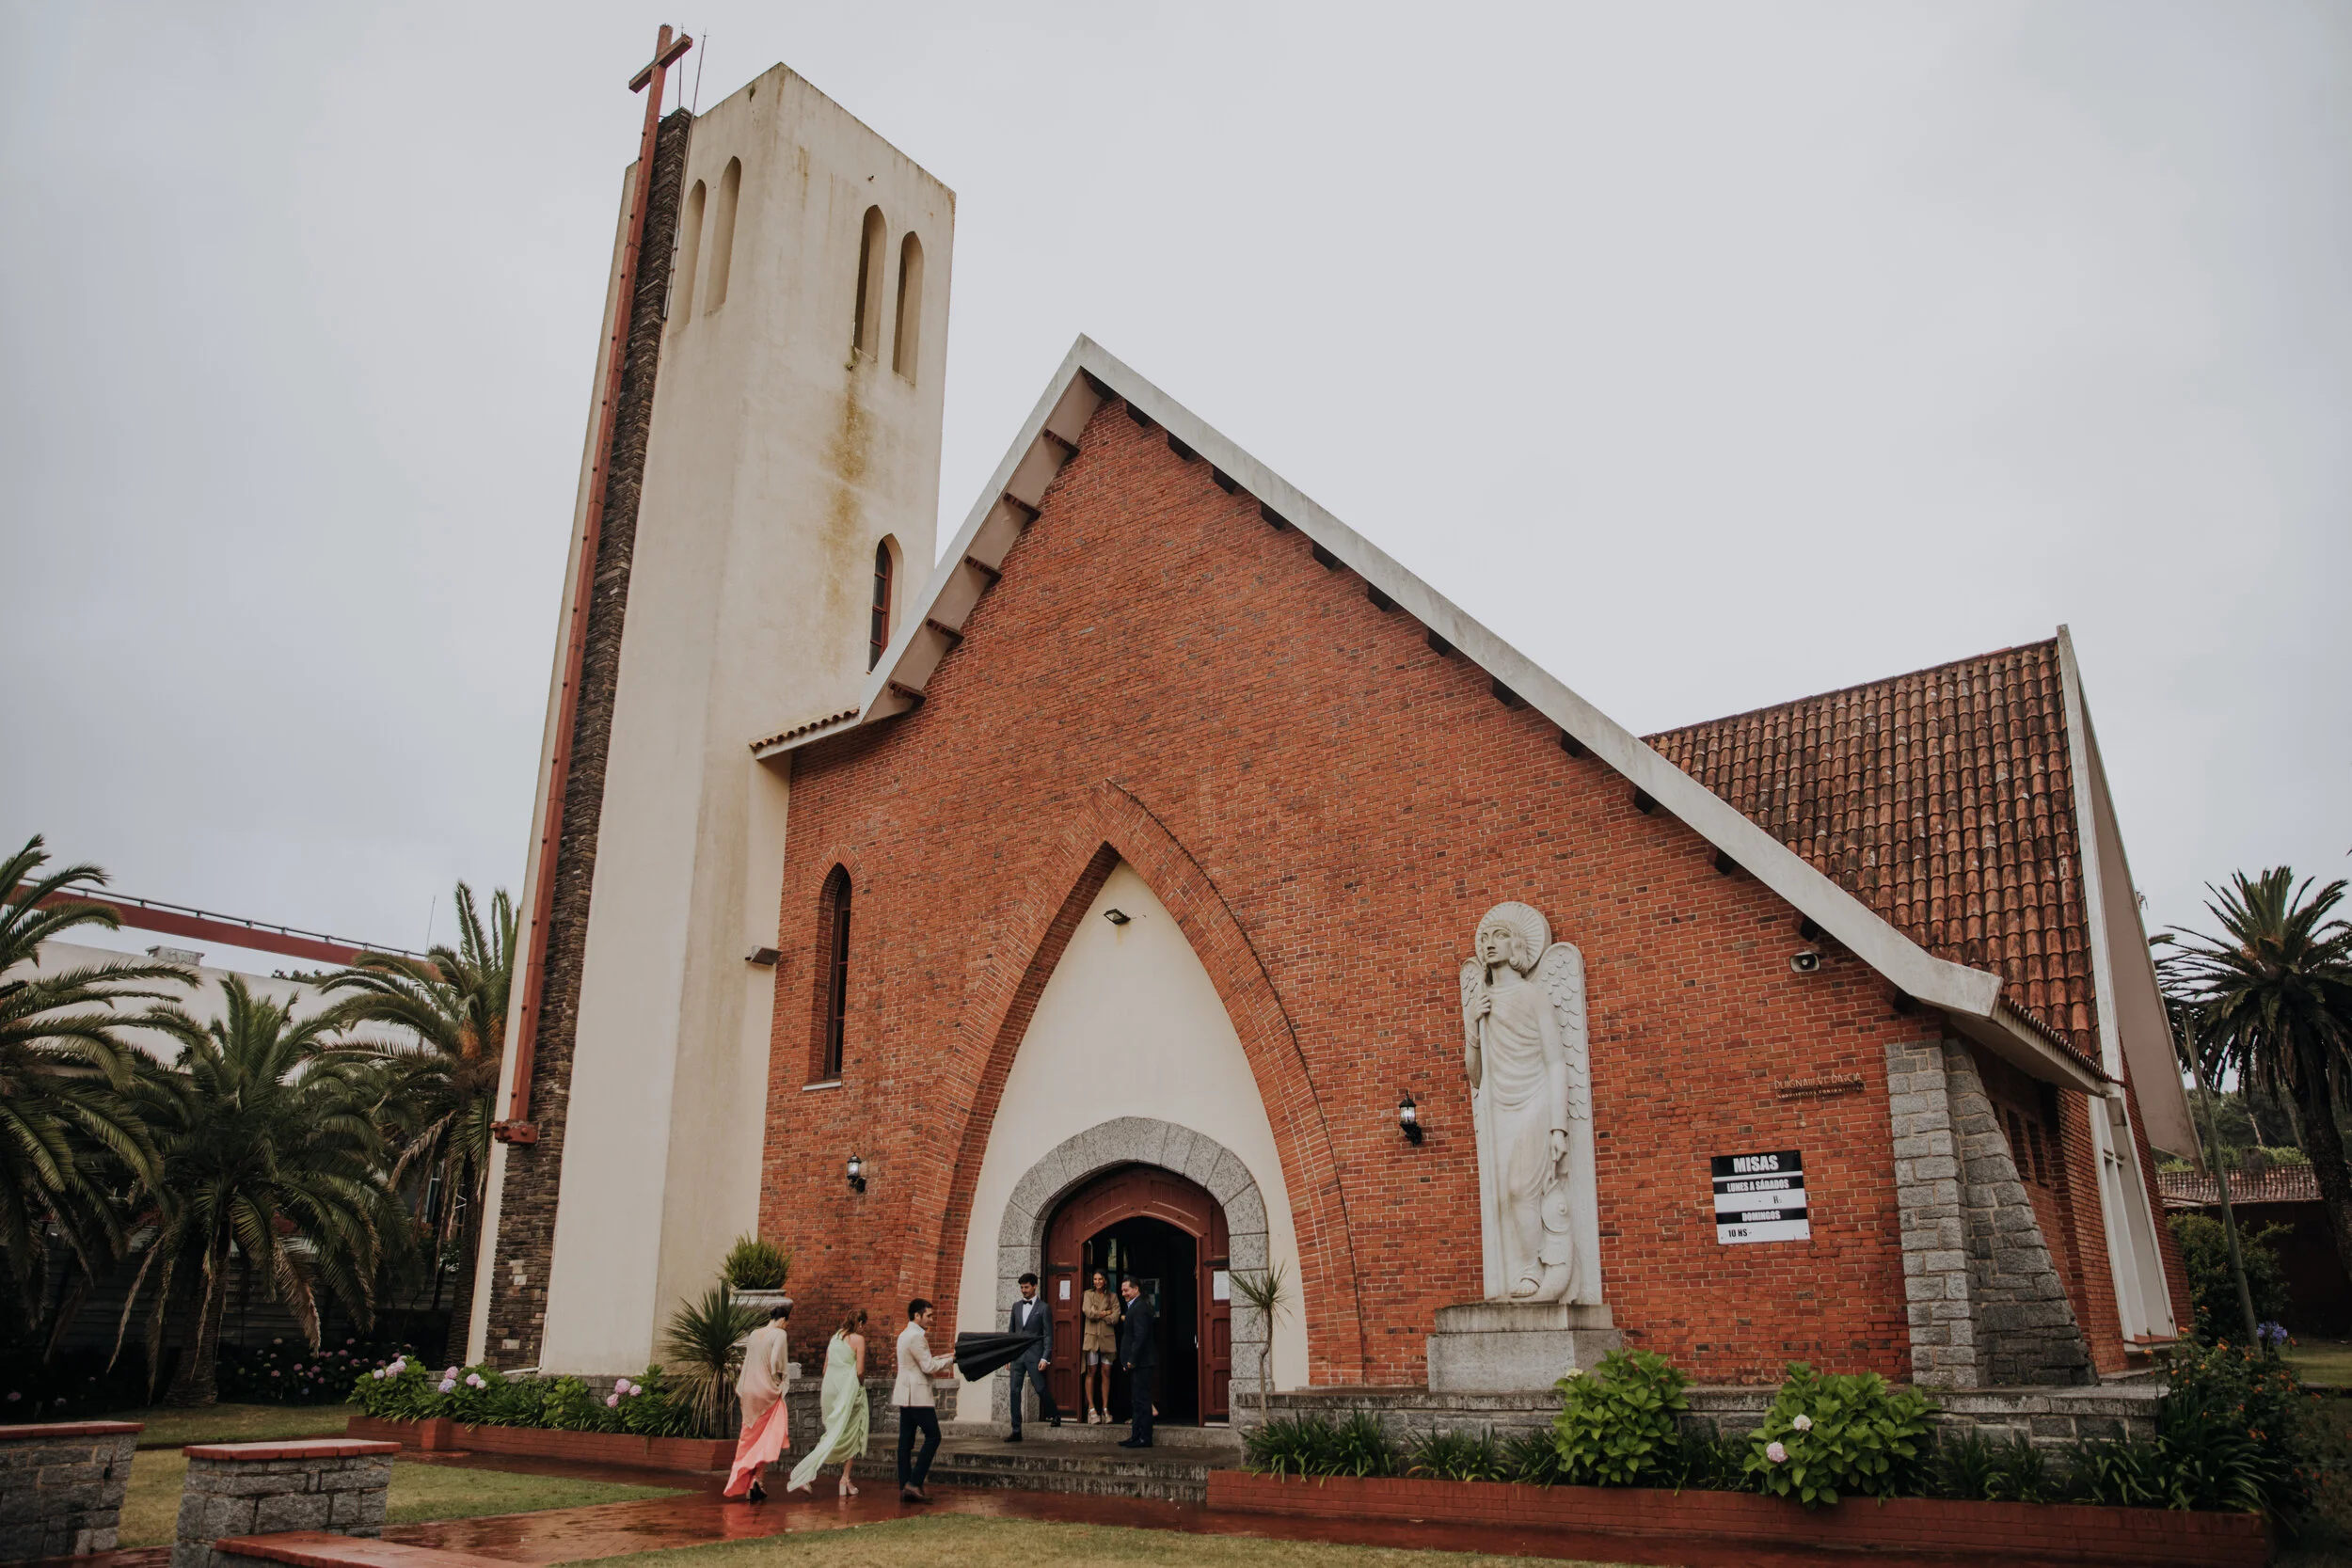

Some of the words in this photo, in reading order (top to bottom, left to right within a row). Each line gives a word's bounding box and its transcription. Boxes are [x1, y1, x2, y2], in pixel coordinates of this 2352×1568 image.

[1733, 1155, 1779, 1173] MISAS
[1727, 1181, 1748, 1193] LUNES
[1750, 1181, 1755, 1191] A
[1742, 1210, 1781, 1222] DOMINGOS
[1728, 1229, 1737, 1238] 10
[1739, 1228, 1747, 1237] HS
